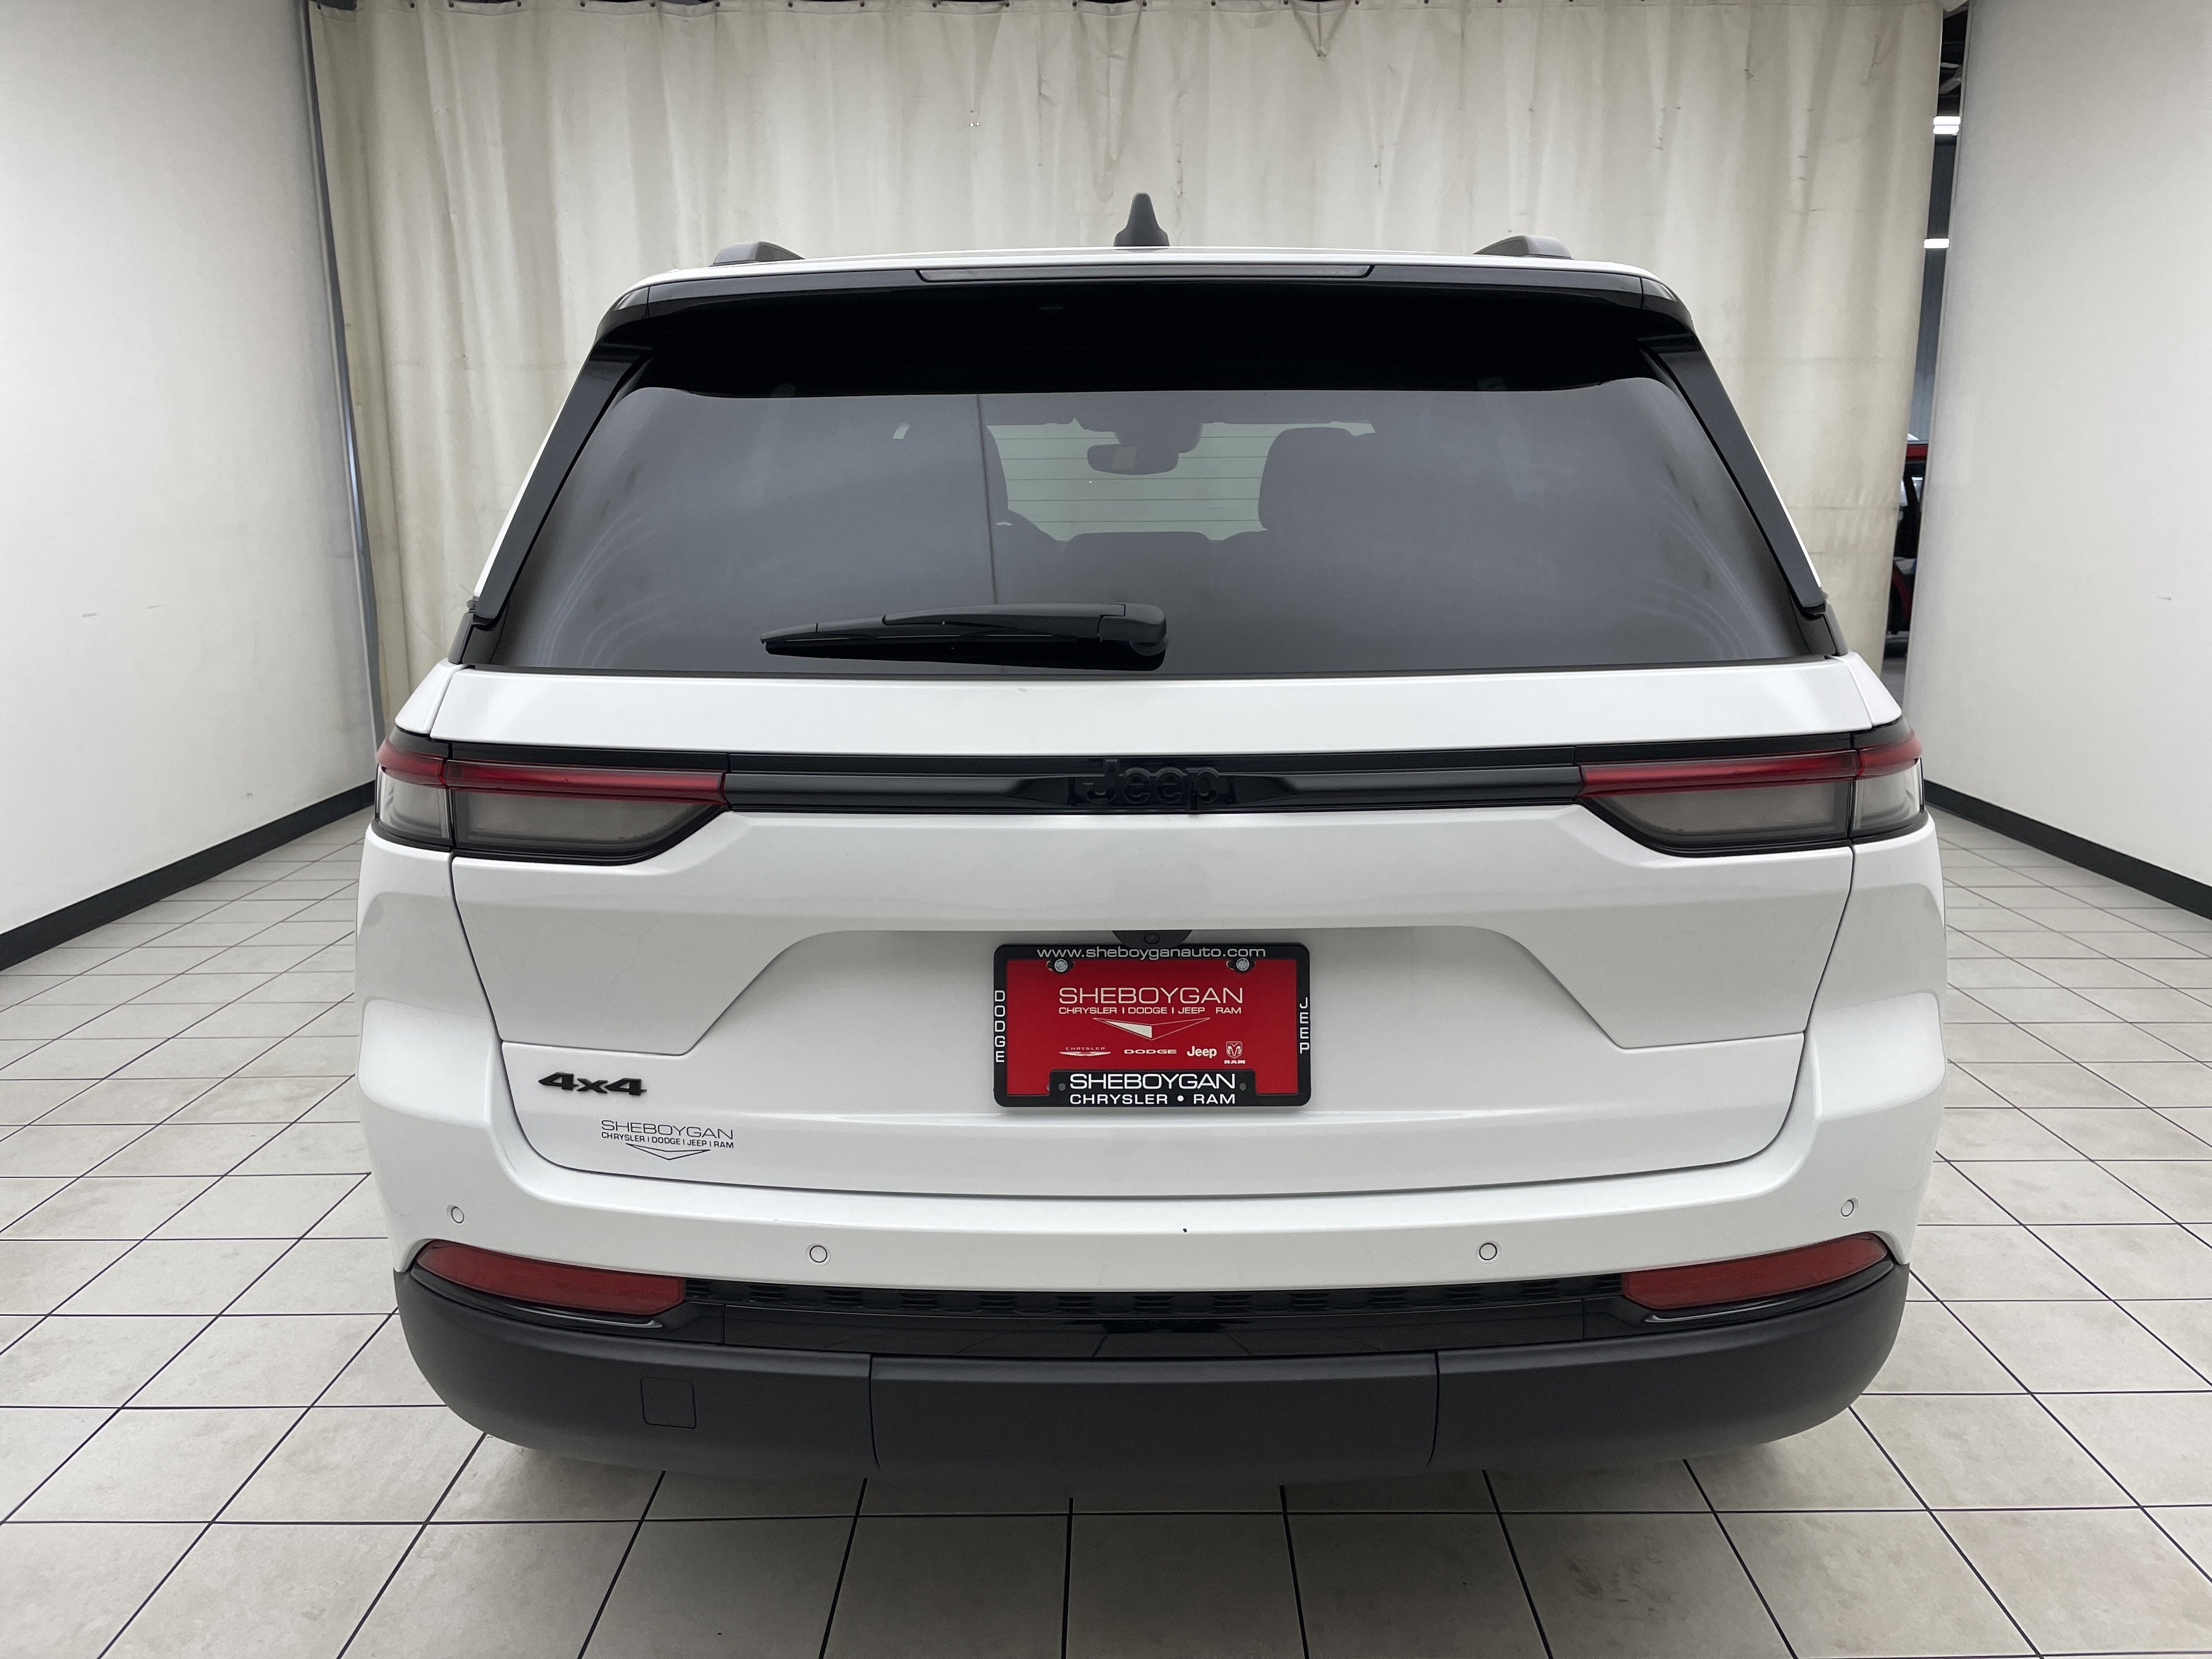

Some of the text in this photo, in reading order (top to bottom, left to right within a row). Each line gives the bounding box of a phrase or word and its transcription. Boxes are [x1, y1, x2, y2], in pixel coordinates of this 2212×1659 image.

[1084, 758, 1220, 813] Jeep
[1036, 946, 1266, 961] www.sheboyganauto.com
[1059, 987, 1243, 1004] SHEBOYGAN
[994, 990, 1006, 1063] DODGE
[1299, 996, 1310, 1054] JEEP
[1187, 1046, 1217, 1059] Jeep
[538, 1072, 647, 1096] 4x4
[1070, 1073, 1235, 1090] SHEBOYGAN
[1070, 1093, 1235, 1104] CHRYSLER RAM
[601, 1120, 733, 1140] SHEBOYGAN
[601, 1132, 645, 1143] CHRYSLER
[652, 1136, 681, 1145] DODGE
[713, 1141, 734, 1149] RAM
